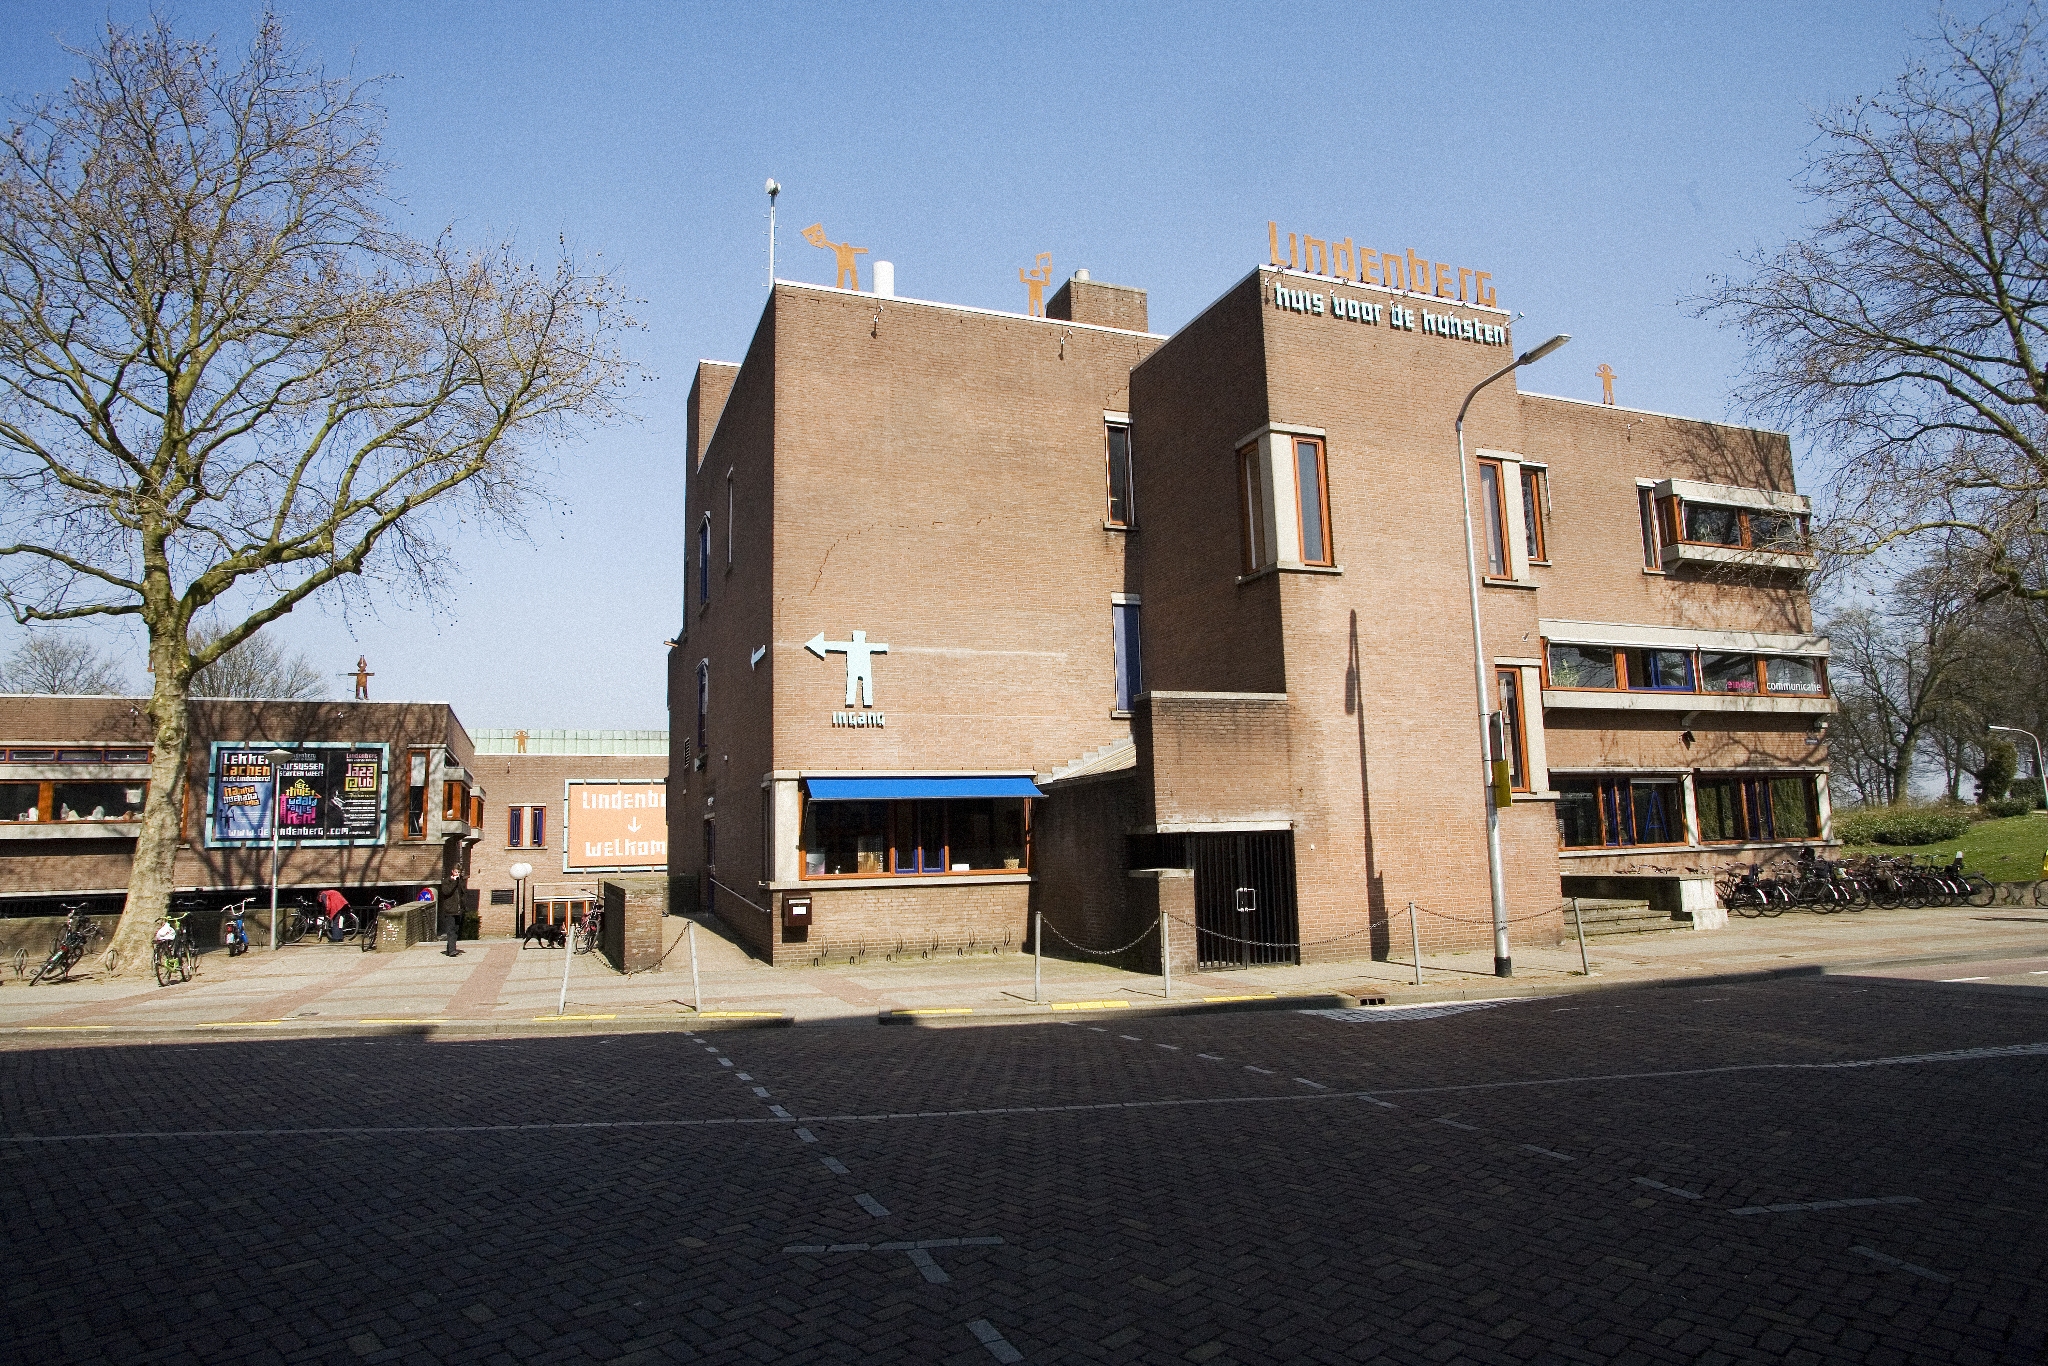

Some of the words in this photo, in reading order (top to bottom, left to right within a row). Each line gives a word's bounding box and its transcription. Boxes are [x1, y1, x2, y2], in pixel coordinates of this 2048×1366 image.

[1268, 221, 1497, 308] Lindenberg
[1275, 282, 1325, 313] huis
[1332, 296, 1383, 322] voor
[1391, 304, 1416, 329] de
[1422, 308, 1505, 343] kunsten
[1766, 680, 1822, 693] communicatie
[345, 763, 374, 777] Jazz
[585, 838, 667, 857] welkom
